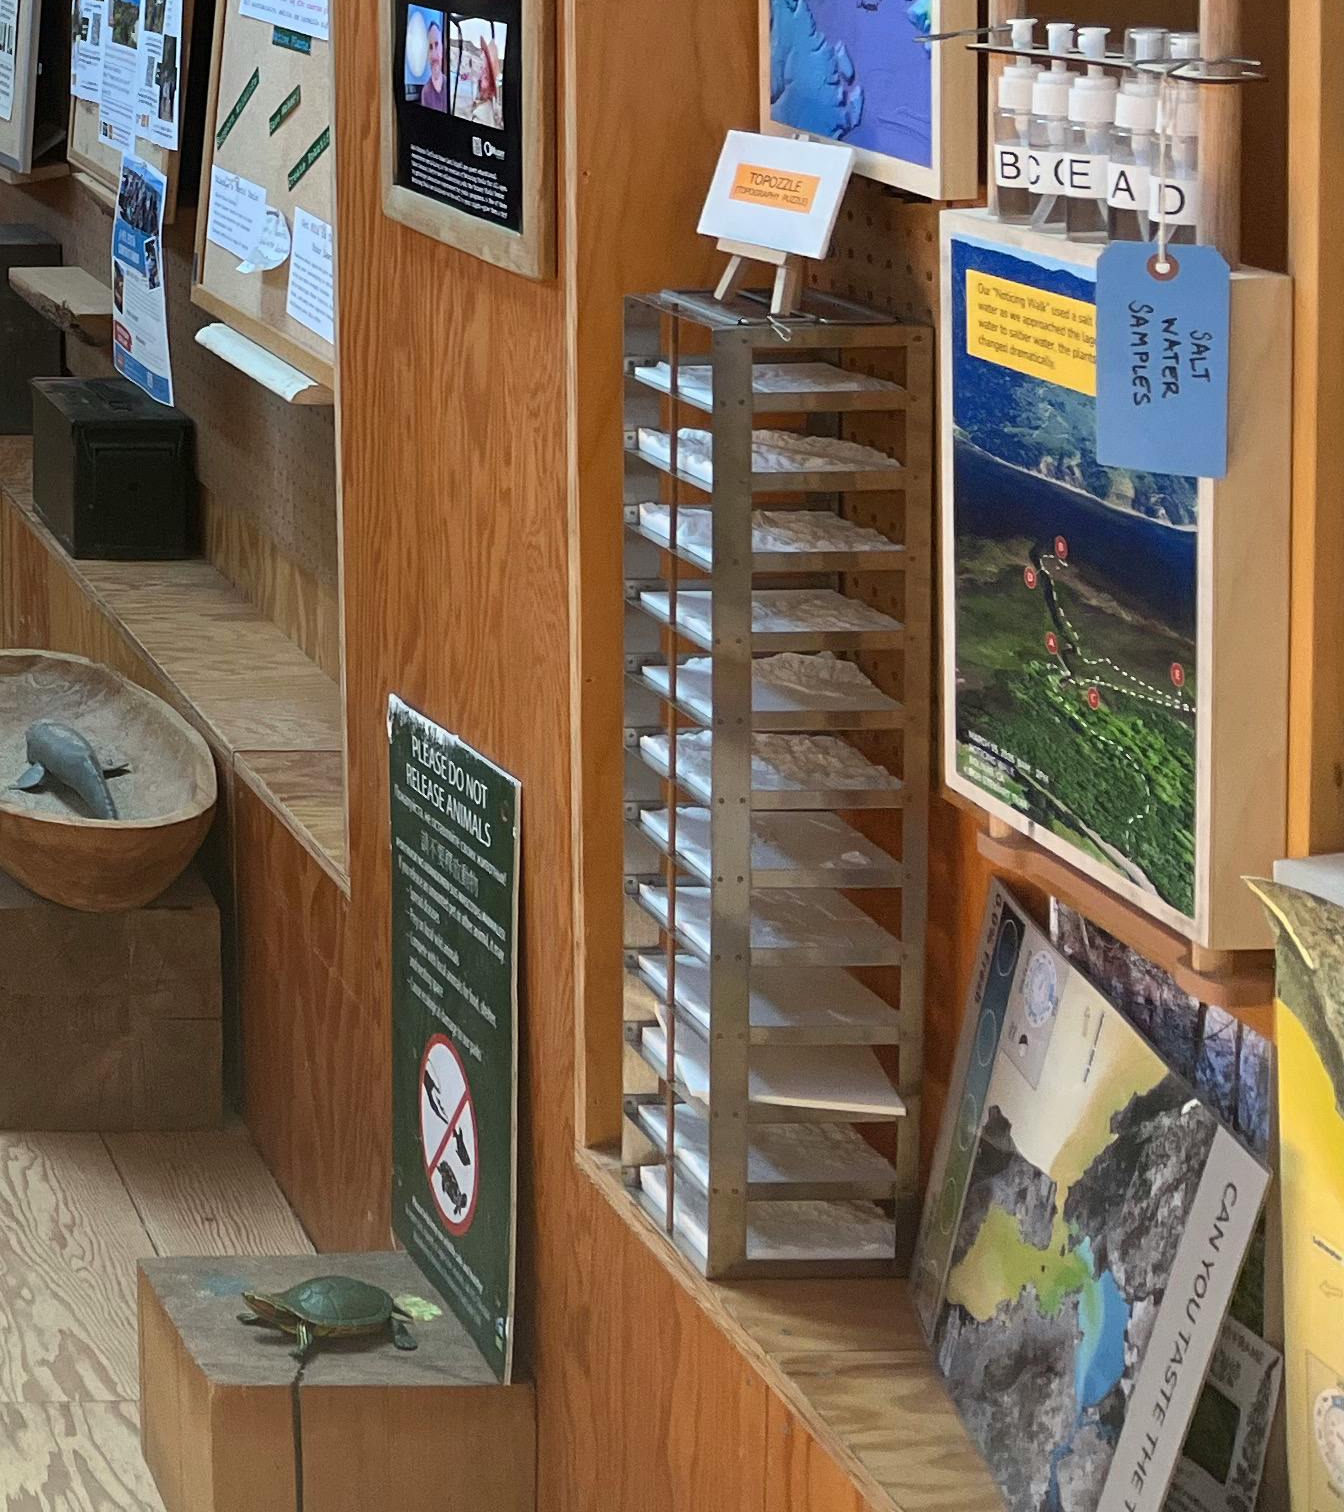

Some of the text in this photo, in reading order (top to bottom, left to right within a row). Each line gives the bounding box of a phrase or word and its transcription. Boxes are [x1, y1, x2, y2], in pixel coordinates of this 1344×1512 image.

[750, 172, 803, 192] TOPOZZLE
[1000, 151, 1021, 179] B
[1070, 159, 1092, 190] E
[1112, 170, 1136, 202] A
[1158, 184, 1185, 216] D
[978, 283, 990, 296] Our
[1052, 307, 1070, 320] used
[979, 303, 997, 315] water
[1000, 309, 1008, 318] as
[1010, 313, 1021, 322] we
[1023, 316, 1066, 336] approached
[1068, 328, 1080, 338] the
[978, 335, 1008, 353] changed
[979, 320, 998, 332] water
[1000, 325, 1007, 335] to
[1057, 343, 1071, 355] the
[1128, 300, 1154, 406] SAMPLES
[1161, 317, 1182, 399] WATER
[1189, 329, 1213, 382] SALT
[412, 736, 488, 809] PLEASE DO NOT
[406, 763, 491, 847] RELEASE ANIMALS
[1131, 1181, 1238, 1494] CAN YOU TASTE THE
